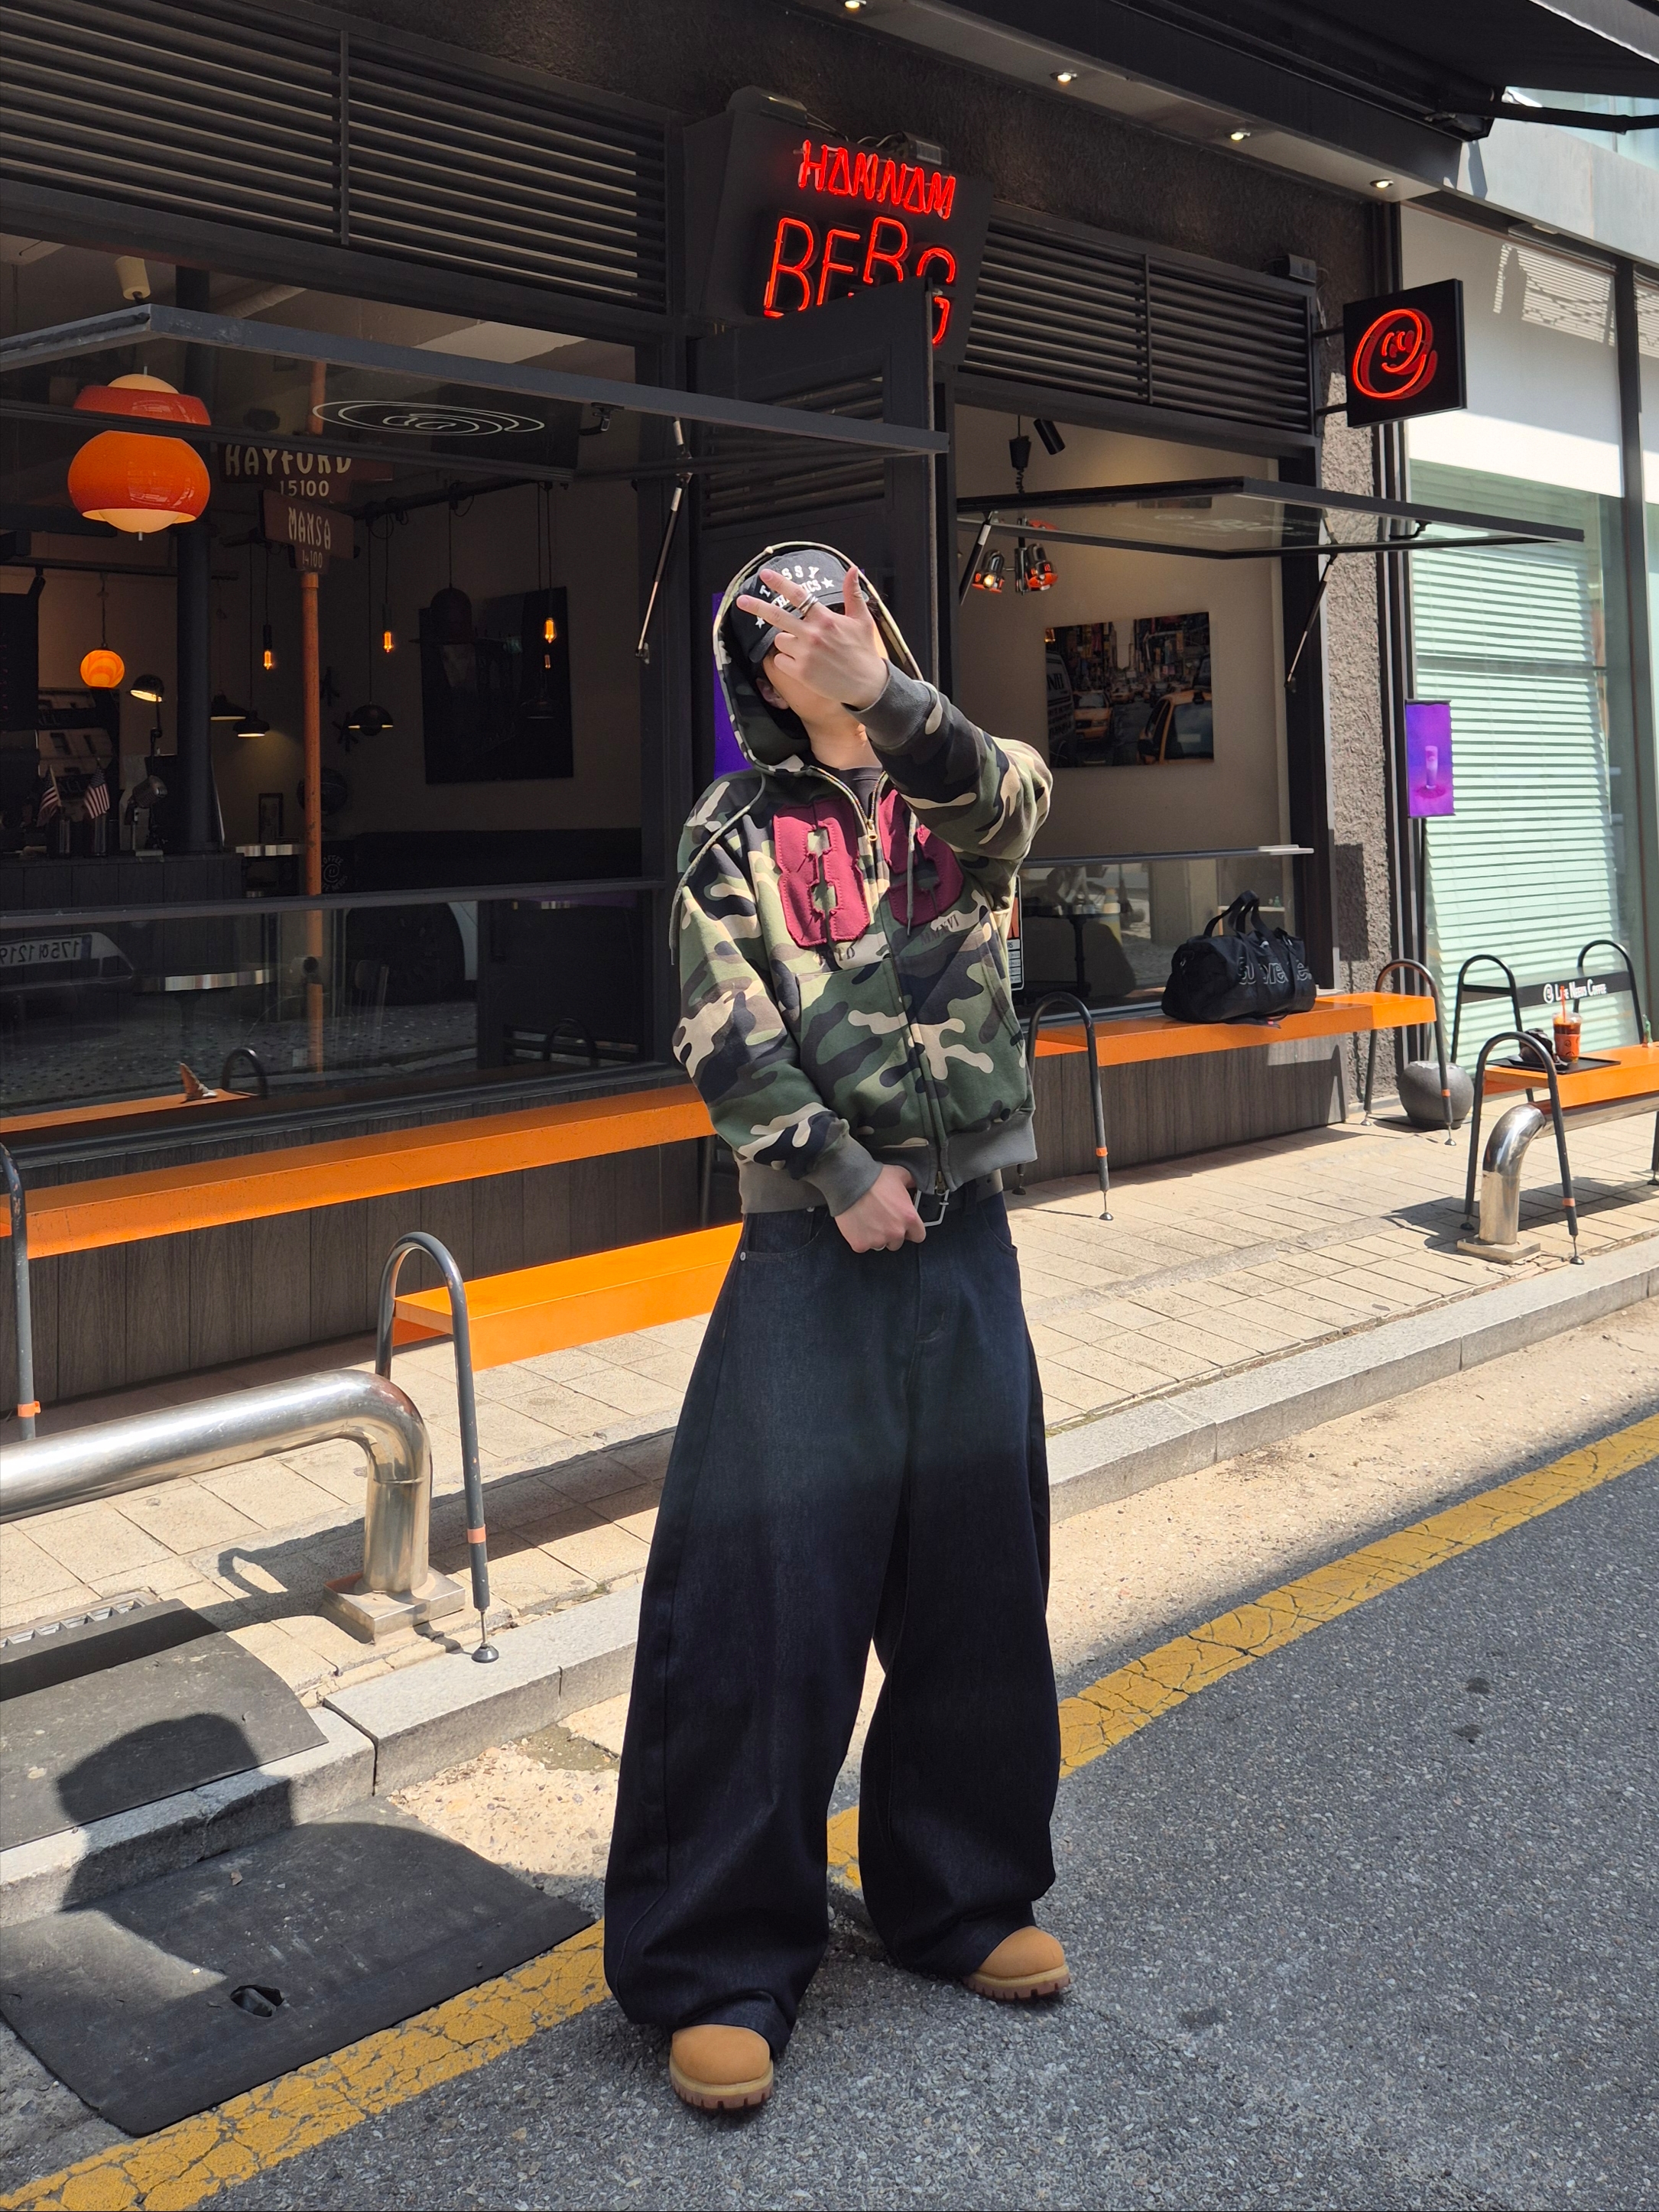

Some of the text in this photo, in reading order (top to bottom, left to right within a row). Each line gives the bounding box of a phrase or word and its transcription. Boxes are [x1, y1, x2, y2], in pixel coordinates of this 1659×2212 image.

[798, 138, 956, 220] HANNAM
[279, 479, 330, 497] 15100
[322, 855, 344, 867] OFFEE
